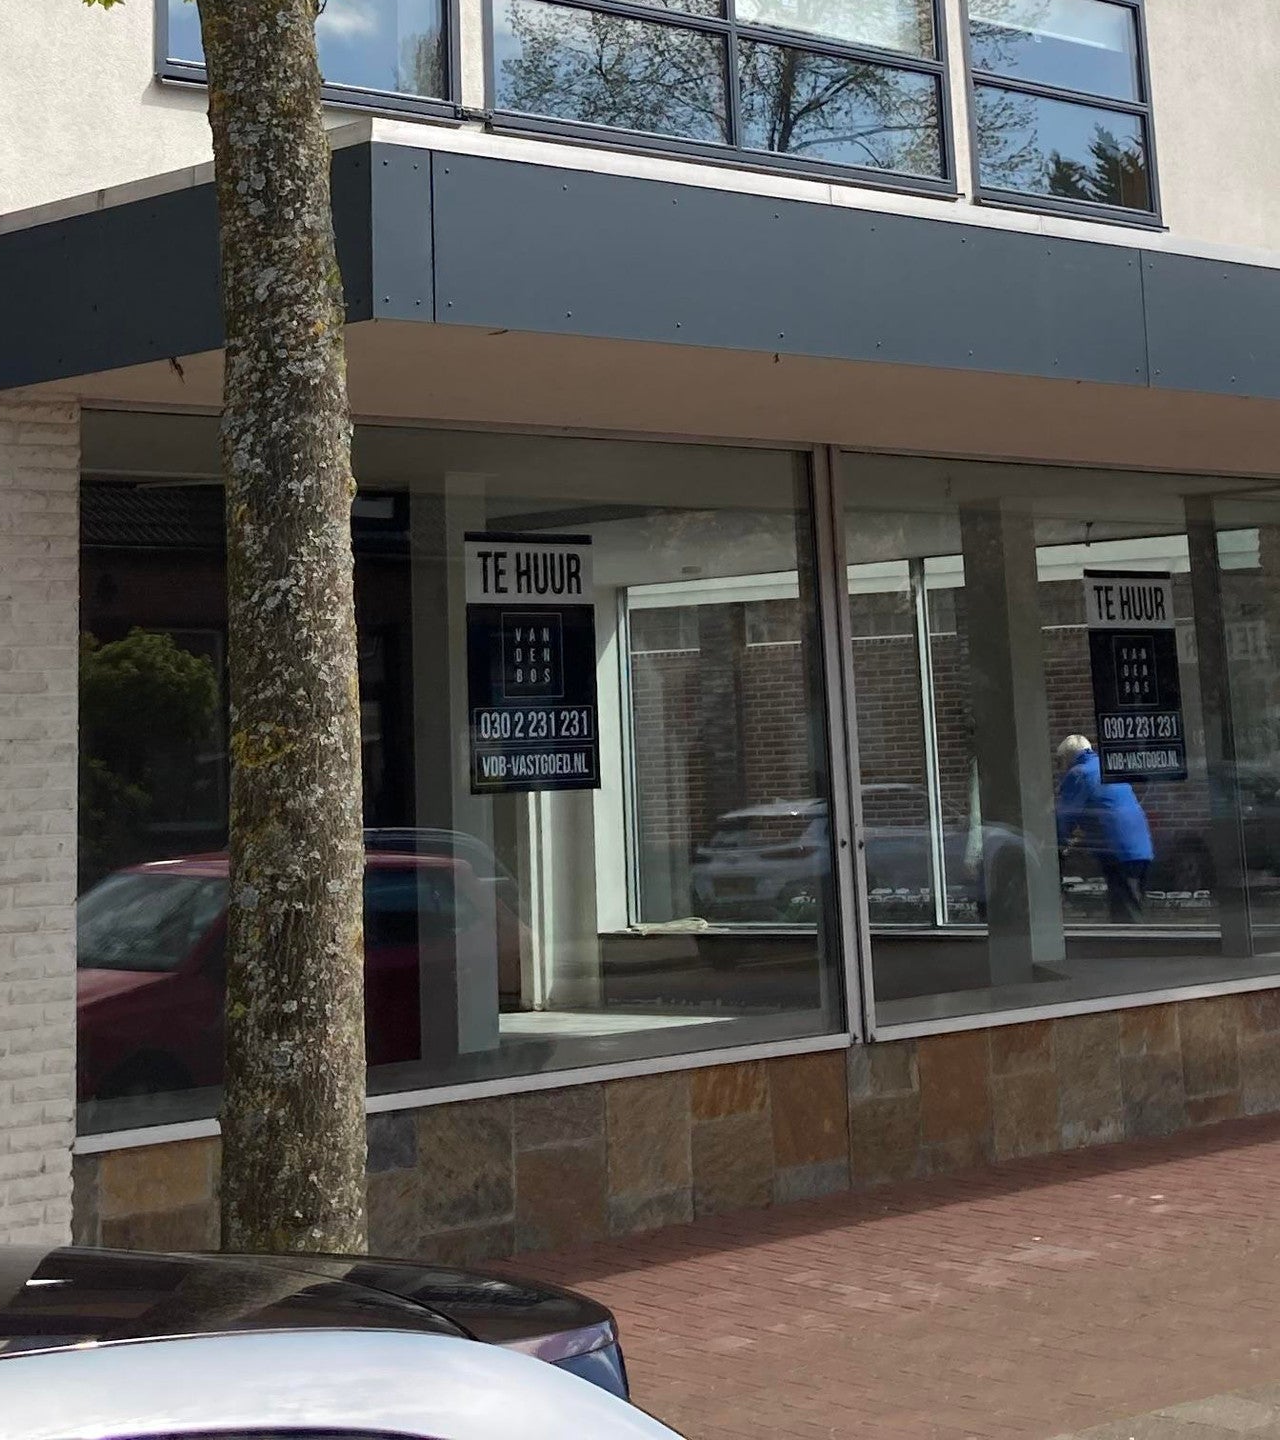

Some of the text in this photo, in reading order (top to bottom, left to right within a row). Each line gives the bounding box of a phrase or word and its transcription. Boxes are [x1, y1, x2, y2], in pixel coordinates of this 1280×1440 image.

[477, 551, 582, 594] TE HUUR
[1093, 585, 1166, 620] TE HUUR
[515, 627, 550, 642] VAN
[515, 647, 551, 663] DEN
[516, 668, 552, 684] BOS
[481, 710, 588, 738] 030 2 231 231
[1103, 717, 1125, 739] 030
[1126, 717, 1134, 738] 2
[1135, 716, 1156, 737] 231
[1157, 715, 1177, 737] 231
[482, 753, 589, 777] VDB-VASTGOED.NL
[1106, 750, 1180, 770] VDB-VASTGOED.NL
